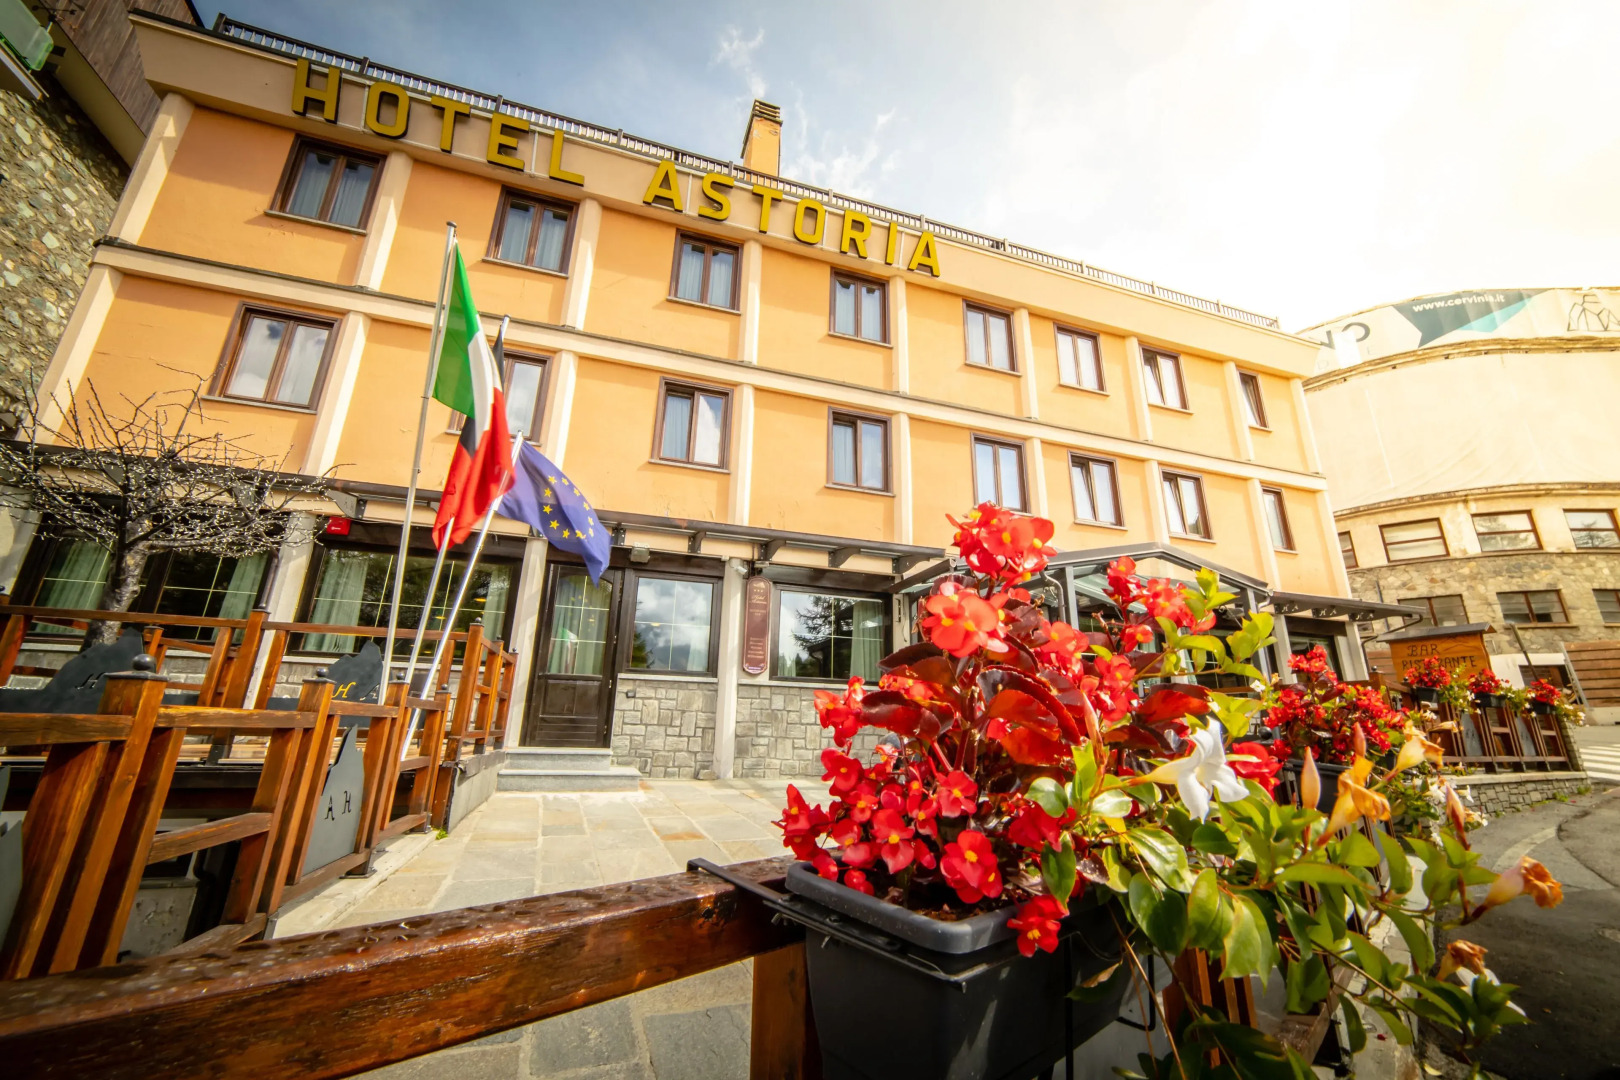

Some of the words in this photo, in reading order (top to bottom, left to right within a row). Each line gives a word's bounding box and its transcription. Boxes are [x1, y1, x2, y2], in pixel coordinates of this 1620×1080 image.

[291, 57, 585, 187] HOTEL
[643, 159, 940, 277] ASTORIA
[1412, 293, 1506, 312] www.cervinia.it
[1407, 644, 1440, 657] BAR
[1402, 656, 1476, 670] RISRANTE
[324, 794, 335, 821] A
[341, 790, 352, 815] H
